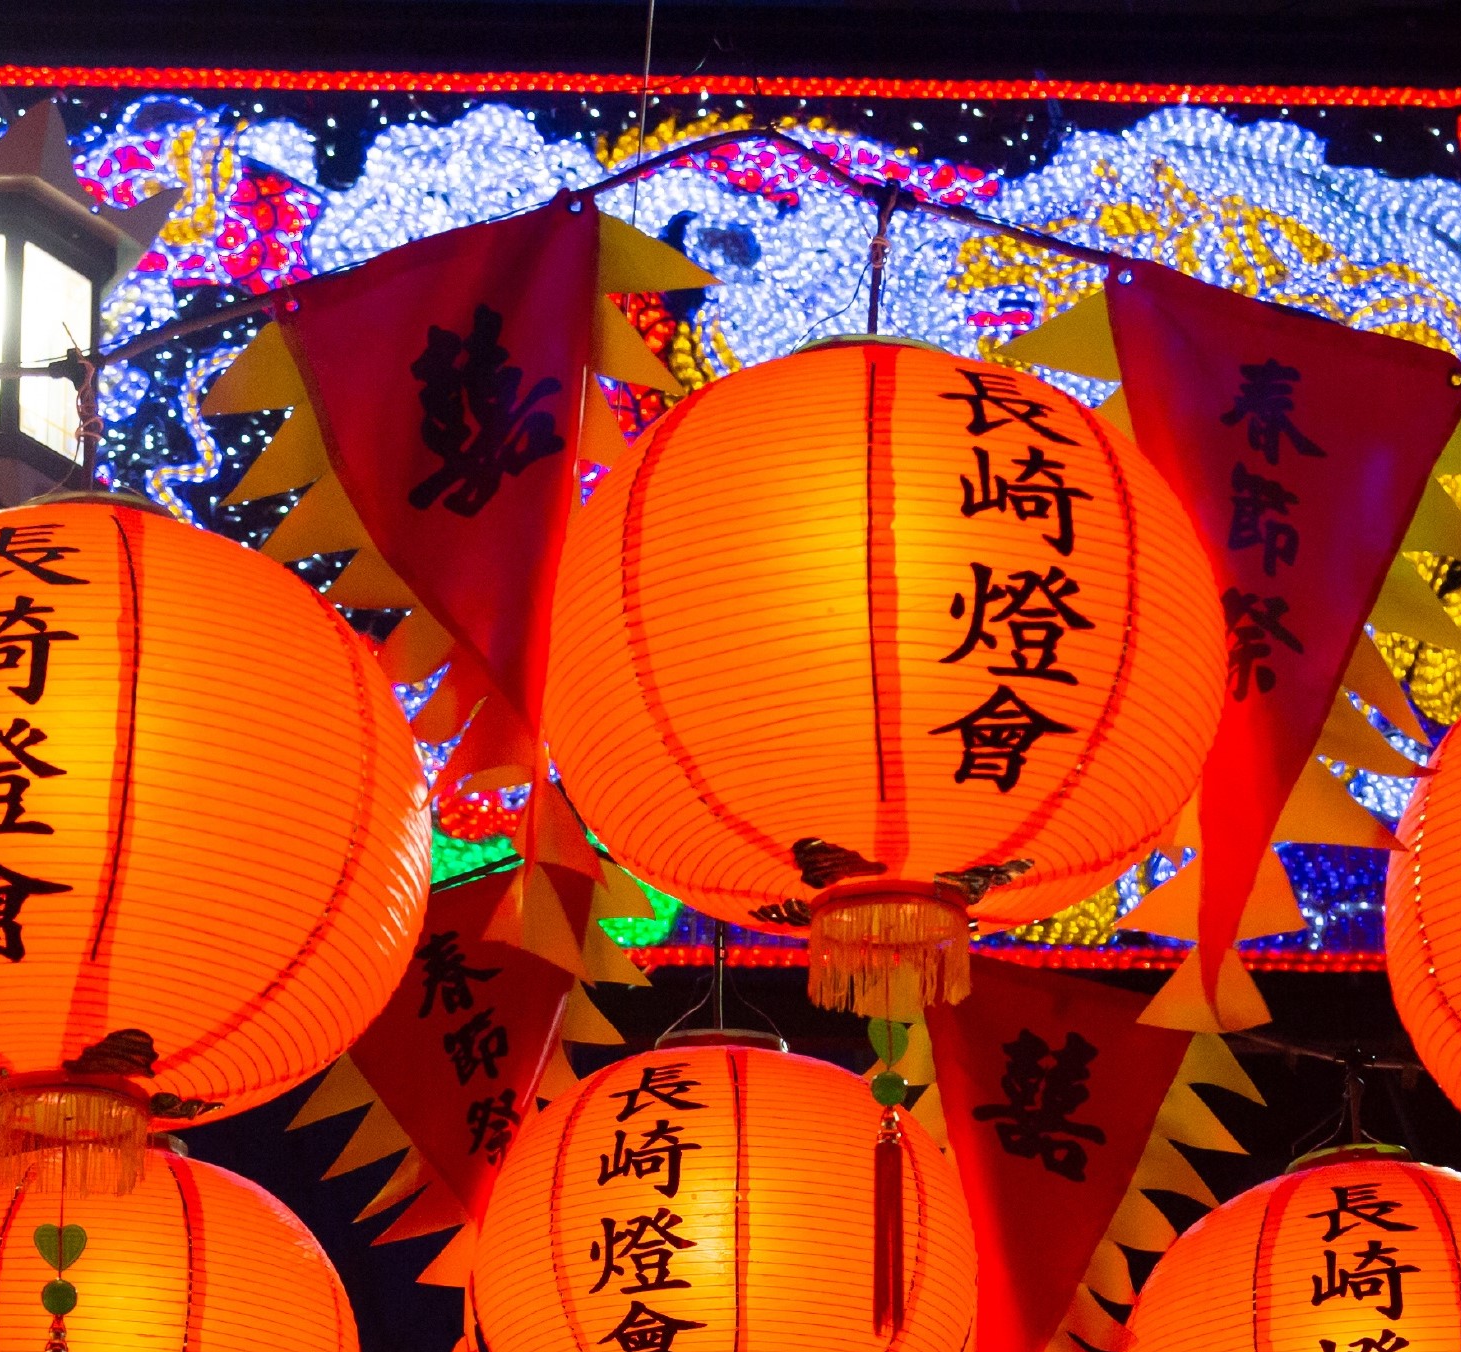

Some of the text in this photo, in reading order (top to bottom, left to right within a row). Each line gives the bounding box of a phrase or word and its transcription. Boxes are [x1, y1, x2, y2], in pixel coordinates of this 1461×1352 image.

[929, 368, 1096, 794] 長崎燈會
[1220, 357, 1328, 703] 春節祭
[415, 931, 521, 1165] 春節祭
